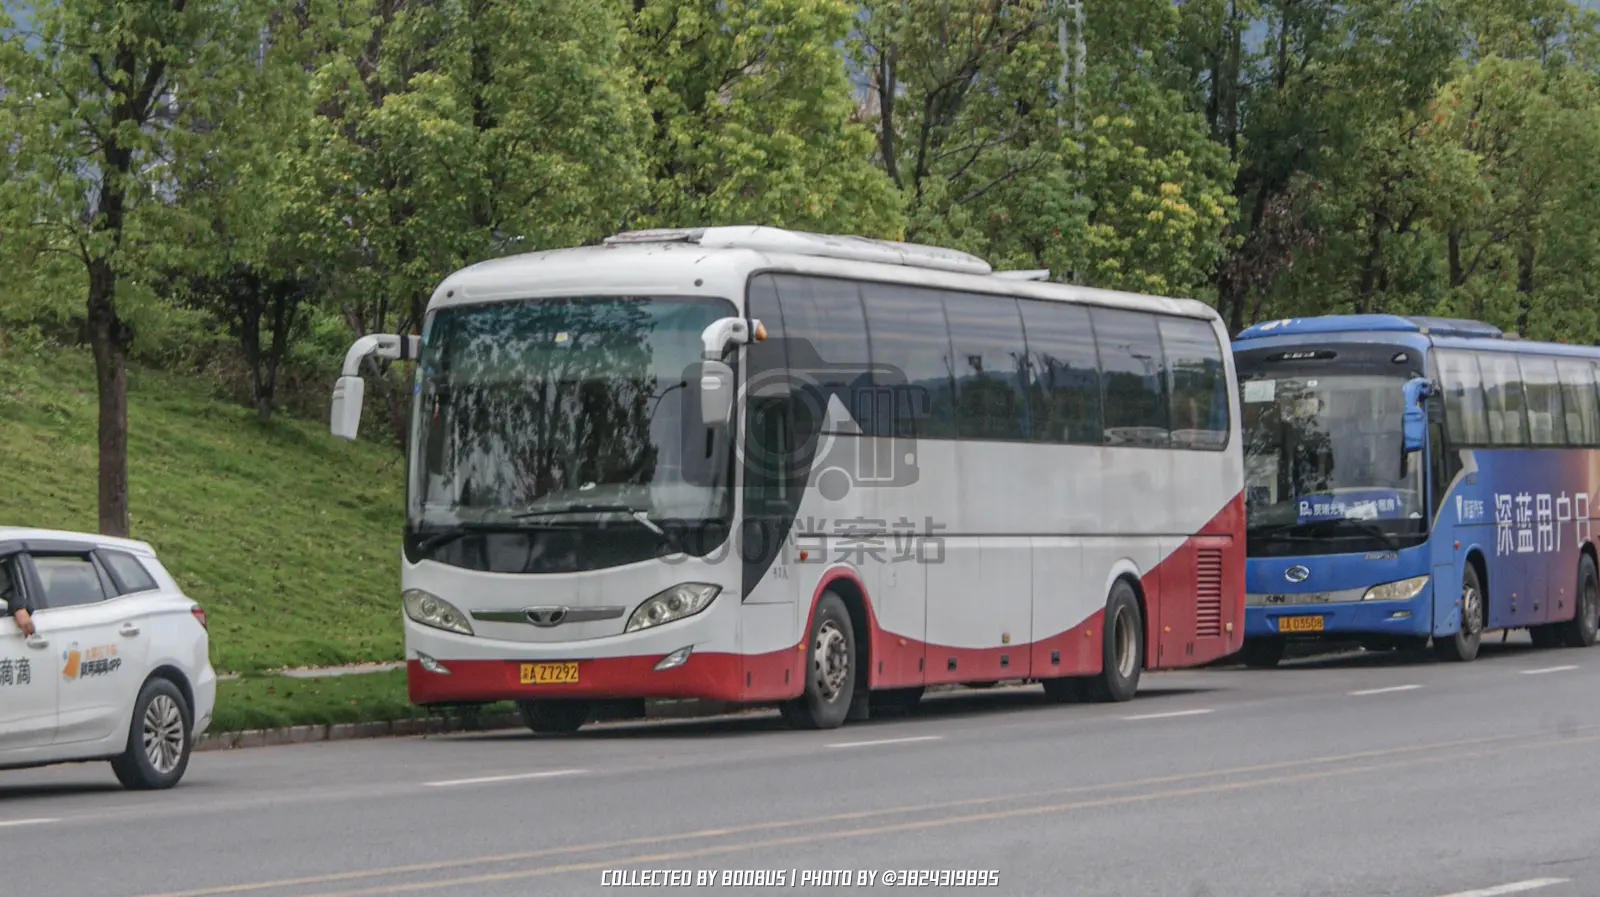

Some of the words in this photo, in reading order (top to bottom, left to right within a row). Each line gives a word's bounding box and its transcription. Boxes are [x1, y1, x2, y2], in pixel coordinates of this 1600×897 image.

[1494, 491, 1591, 557] 深蓝用户日
